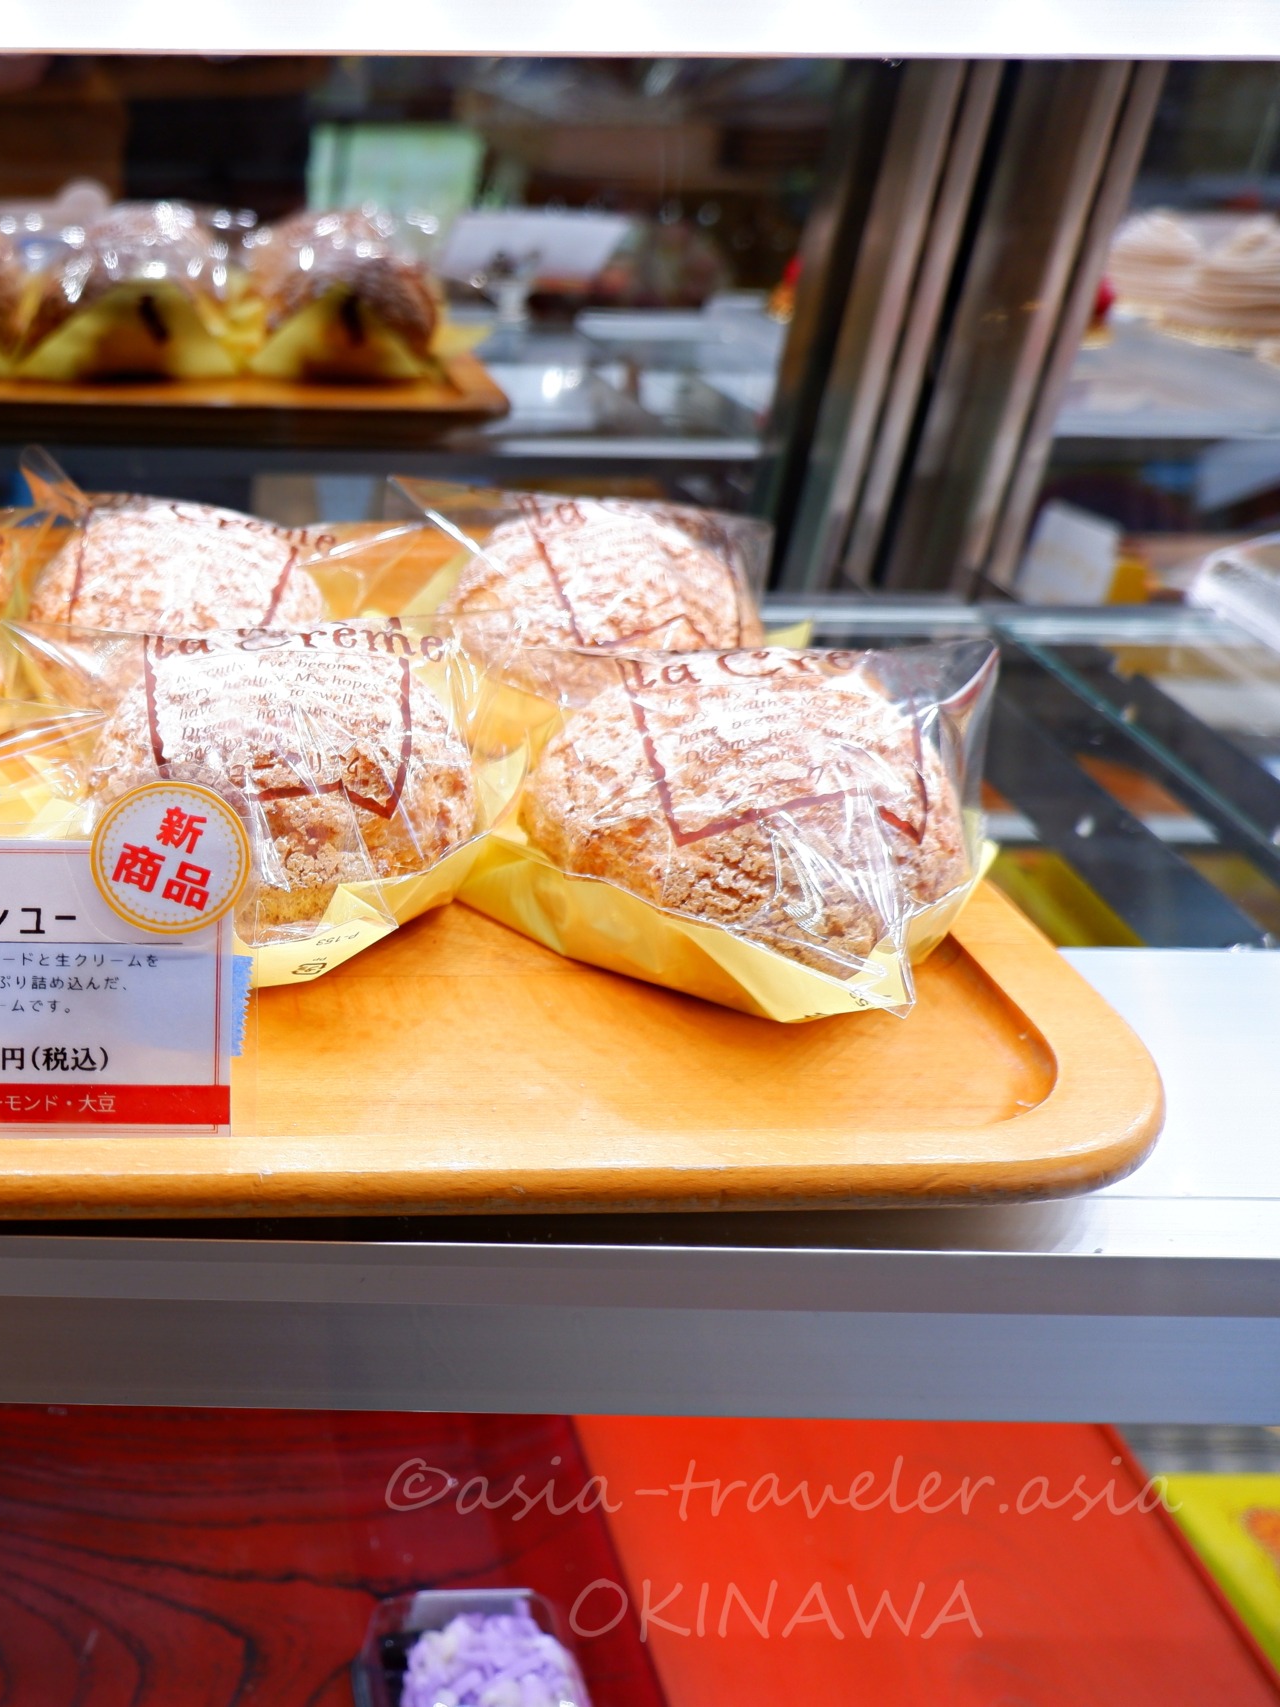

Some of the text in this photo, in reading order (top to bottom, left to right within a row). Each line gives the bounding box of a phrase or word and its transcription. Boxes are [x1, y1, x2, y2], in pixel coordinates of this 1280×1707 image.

[297, 658, 361, 672] become
[332, 675, 380, 692] hopes
[179, 704, 217, 721] have
[156, 806, 207, 854] 新
[112, 843, 211, 911] 商品
